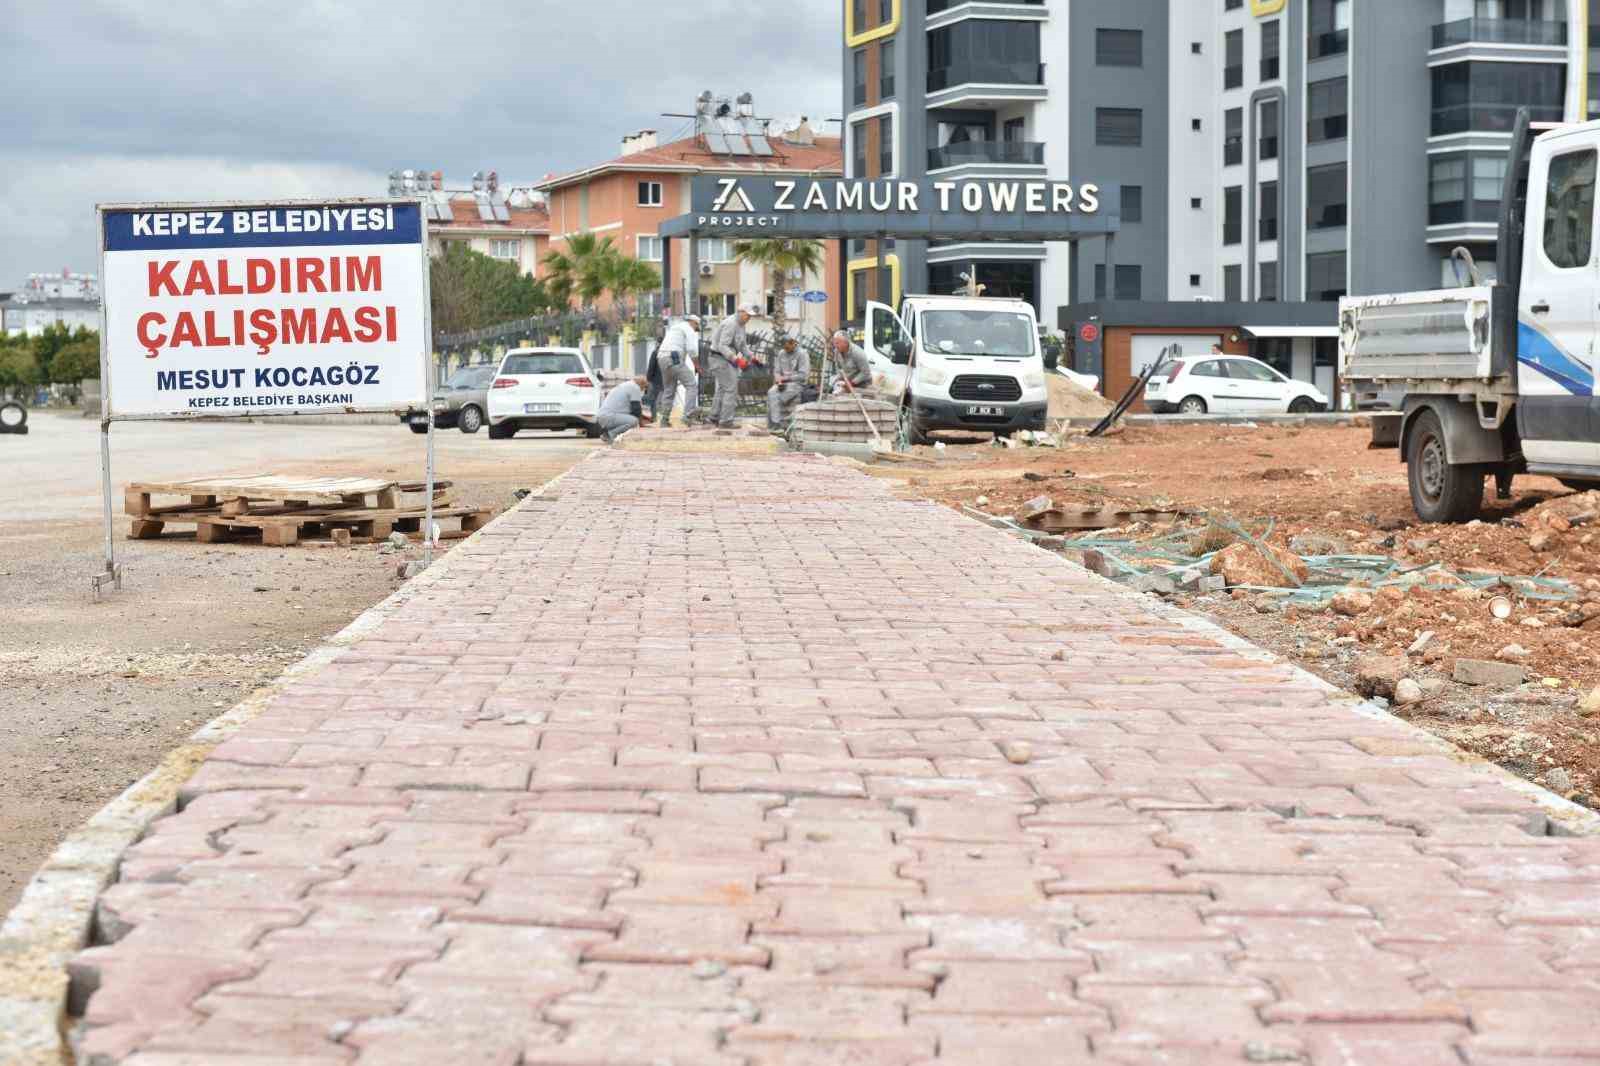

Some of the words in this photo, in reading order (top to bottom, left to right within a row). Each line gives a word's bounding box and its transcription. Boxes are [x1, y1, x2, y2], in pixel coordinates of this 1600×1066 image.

[774, 181, 919, 211] ZAMUR
[934, 182, 1099, 212] TOWERS
[133, 212, 225, 236] KEPEZ
[232, 205, 394, 233] BELEDİYESİ
[698, 216, 780, 225] PROJECT
[148, 256, 382, 297] KALDIRIM
[137, 306, 397, 358] ÇALIŞMASI
[157, 369, 245, 390] MESUT
[255, 362, 379, 388] KOCAGÖZ
[189, 397, 229, 408] KEPEZ
[233, 395, 294, 406] BELEDİYE
[298, 394, 353, 406] BAŞKANI
